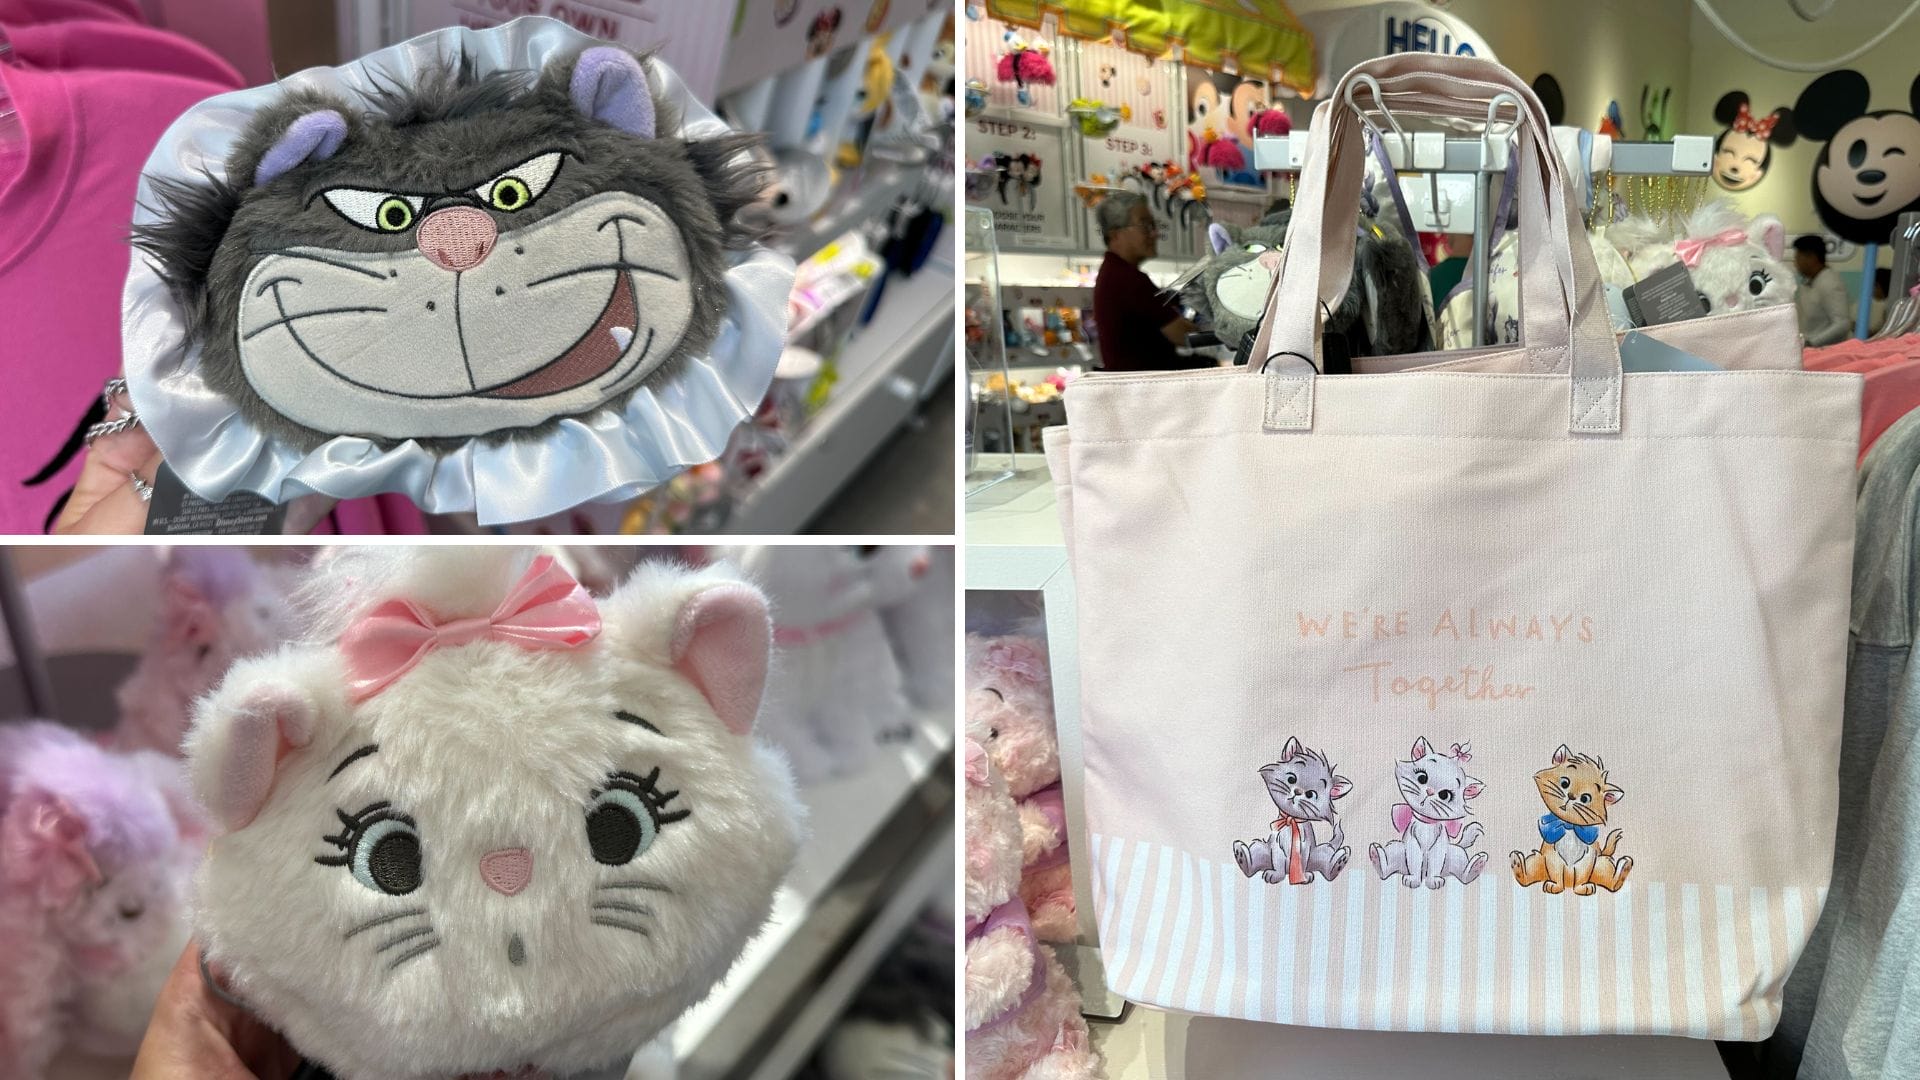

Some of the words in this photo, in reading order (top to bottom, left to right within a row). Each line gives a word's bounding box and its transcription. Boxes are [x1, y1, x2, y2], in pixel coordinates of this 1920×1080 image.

[977, 119, 1018, 137] STEP
[1023, 126, 1036, 141] 2:
[1106, 136, 1137, 154] STEP
[1296, 607, 1408, 640] WE'RE
[1431, 607, 1594, 644] ALWAYS
[1342, 660, 1536, 711] Together
